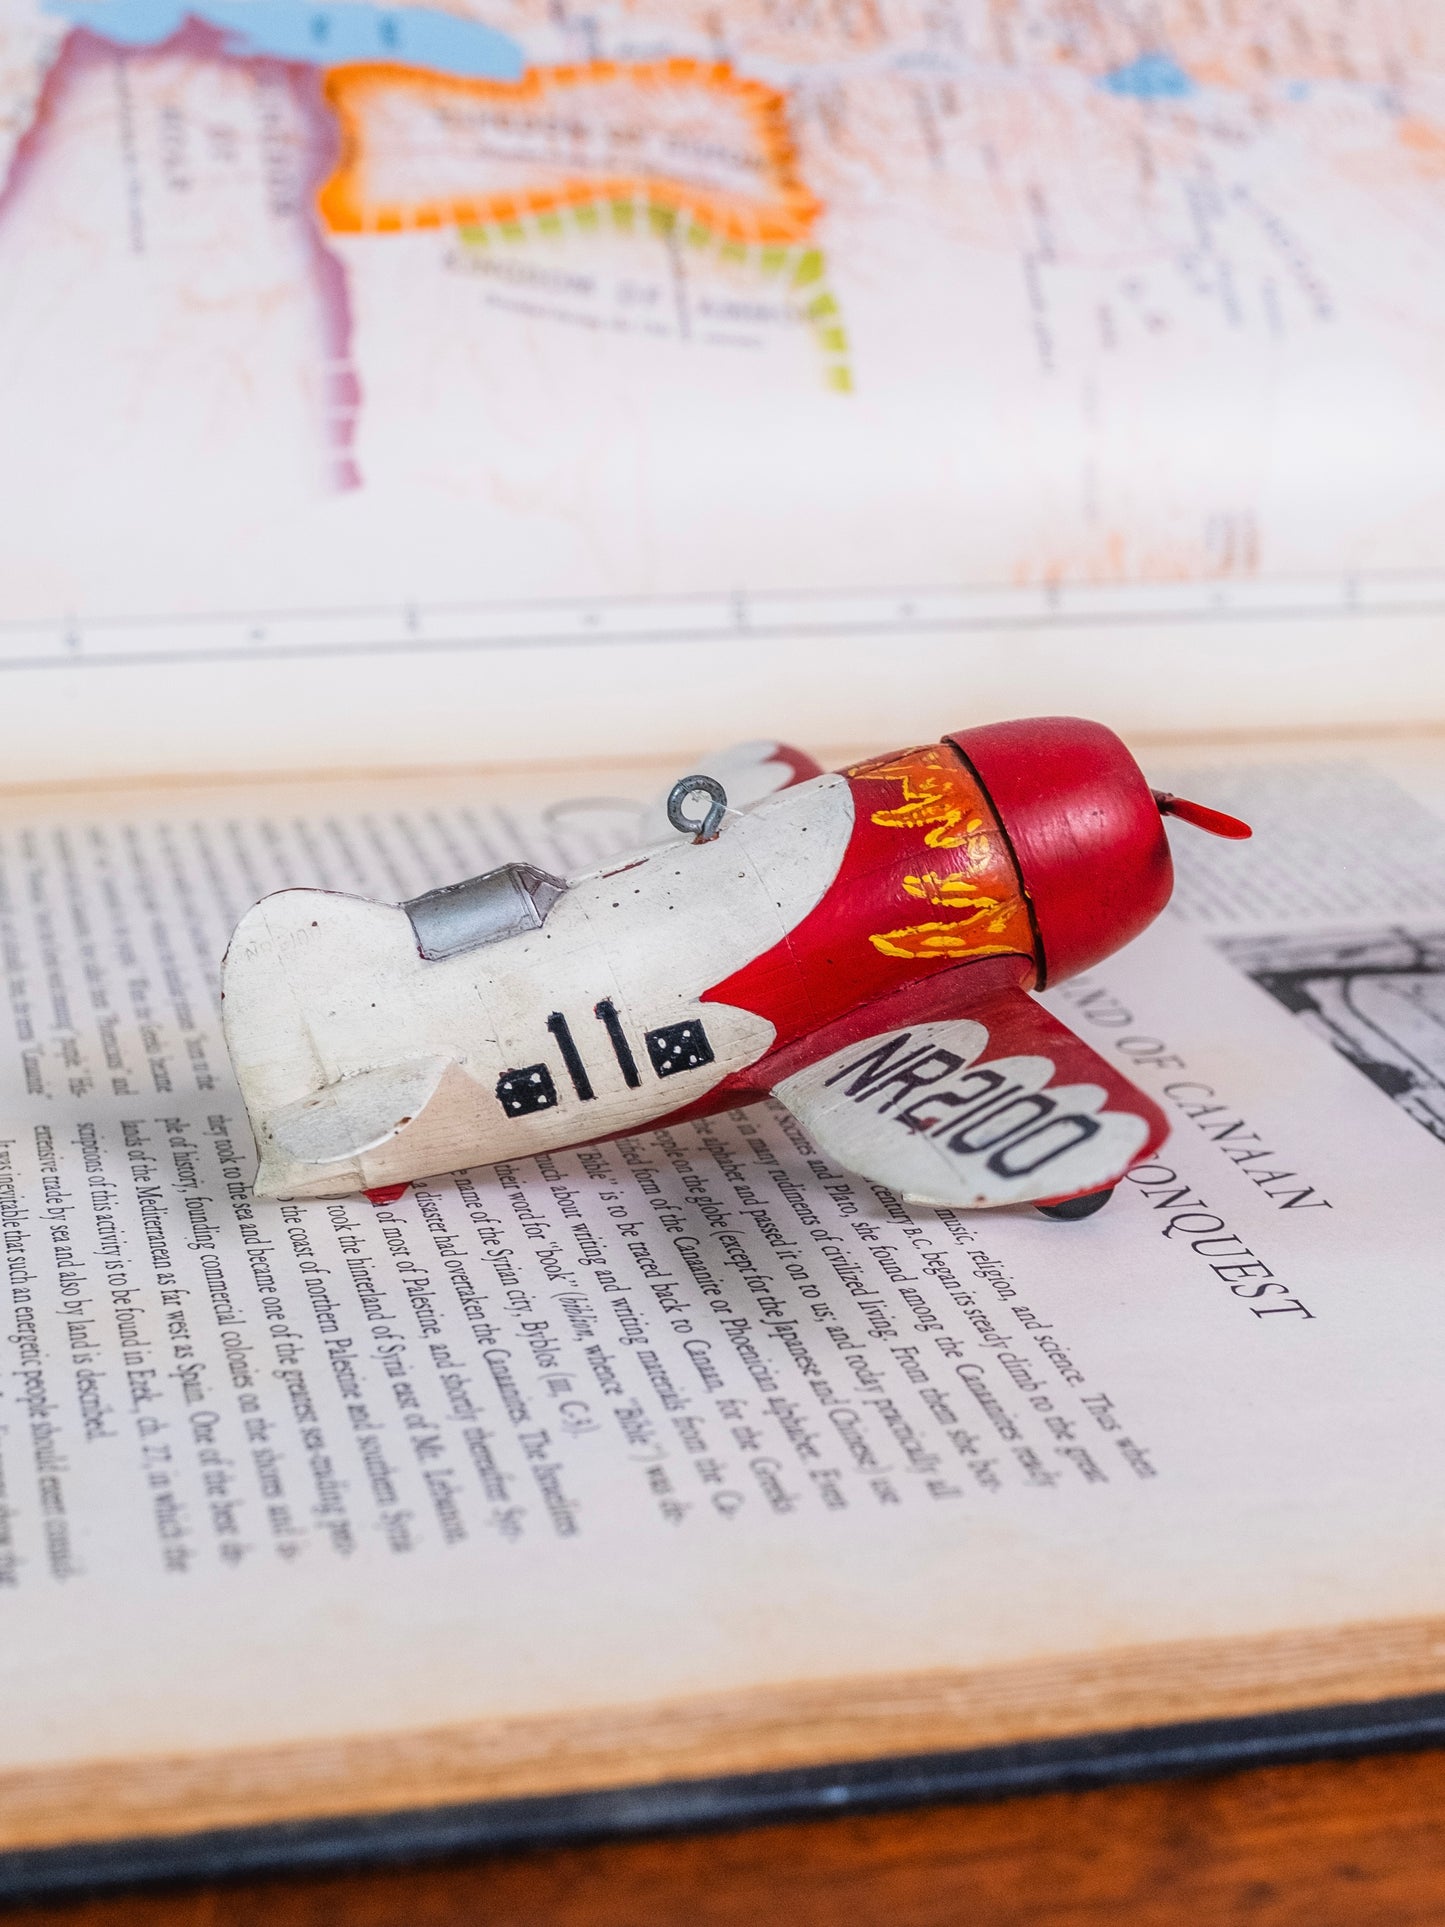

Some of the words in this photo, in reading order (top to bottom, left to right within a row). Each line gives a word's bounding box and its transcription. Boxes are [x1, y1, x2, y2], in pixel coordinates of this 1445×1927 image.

[824, 1033, 1101, 1180] NR2100
[1114, 1035, 1186, 1071] OF
[1163, 1081, 1333, 1211] CANAAN
[127, 1149, 157, 1162] of
[571, 1146, 618, 1185] “Bible”
[671, 1159, 693, 1174] on
[87, 1175, 118, 1188] of
[130, 1164, 157, 1182] the
[171, 1151, 204, 1193] history,
[222, 1166, 242, 1179] to
[490, 1164, 526, 1189] their
[631, 1168, 661, 1195] form
[806, 1159, 845, 1180] and
[42, 1175, 72, 1204] trade
[226, 1180, 256, 1200] the
[406, 1181, 428, 1189] a
[453, 1178, 482, 1208] name
[598, 1191, 624, 1201] is
[681, 1175, 709, 1193] the
[733, 1185, 769, 1206] and
[0, 1173, 29, 1227] inevitable
[90, 1190, 119, 1211] this
[508, 1191, 545, 1220] word
[550, 1185, 582, 1218] about
[649, 1198, 682, 1211] of
[768, 1169, 820, 1225] rudiments
[823, 1183, 875, 1217] Plato,
[38, 1206, 75, 1221] by
[184, 1196, 220, 1250] founding
[232, 1202, 254, 1221] sea
[280, 1205, 307, 1223] the
[326, 1205, 360, 1232] took
[375, 1211, 407, 1223] of
[414, 1191, 447, 1232] disaster
[469, 1211, 502, 1223] of
[606, 1205, 628, 1218] to
[658, 1213, 687, 1233] the
[684, 1196, 731, 1227] globe
[49, 1224, 70, 1243] sea
[93, 1214, 127, 1256] activity
[136, 1186, 171, 1268] Mediterranean
[238, 1223, 272, 1245] and
[476, 1226, 504, 1245] the
[521, 1222, 551, 1239] for
[616, 1221, 644, 1237] be
[738, 1209, 797, 1247] passed
[809, 1229, 844, 1242] of
[850, 1222, 880, 1241] she
[1124, 1153, 1317, 1320] ONQUEST
[3, 1230, 30, 1254] that
[287, 1227, 314, 1257] coast
[337, 1235, 365, 1254] the
[382, 1227, 410, 1256] most
[433, 1234, 468, 1257] had
[571, 1223, 607, 1265] writing
[709, 1230, 757, 1273] (except
[872, 1181, 914, 1226] century
[902, 1227, 932, 1249] B.C.
[921, 1251, 961, 1289] began
[949, 1291, 976, 1306] its
[54, 1245, 85, 1268] and
[104, 1259, 132, 1270] is
[395, 1260, 429, 1273] of
[481, 1248, 521, 1286] Syrian
[535, 1241, 578, 1287] “book”
[627, 1241, 672, 1278] traced
[673, 1236, 723, 1295] Canaanite
[775, 1250, 802, 1260] it
[868, 1245, 918, 1282] found
[6, 1256, 37, 1285] such
[107, 1272, 127, 1286] to
[156, 1272, 176, 1285] as
[246, 1247, 276, 1293] became
[298, 1261, 331, 1274] of
[785, 1263, 809, 1281] on
[821, 1245, 879, 1296] civilized
[933, 1207, 978, 1246] music,
[967, 1250, 1016, 1301] religion,
[1011, 1306, 1053, 1330] and
[58, 1271, 87, 1296] also
[200, 1254, 245, 1325] commercial
[346, 1257, 395, 1320] hinterland
[444, 1260, 488, 1320] overtaken
[594, 1269, 632, 1292] and
[743, 1275, 773, 1293] for
[798, 1284, 821, 1298] to
[11, 1287, 31, 1304] an
[55, 1298, 93, 1315] by
[111, 1288, 140, 1304] be
[160, 1289, 190, 1305] far
[304, 1278, 340, 1333] northern
[503, 1289, 536, 1317] city,
[650, 1282, 690, 1313] back
[709, 1299, 732, 1314] or
[756, 1296, 786, 1317] the
[261, 1296, 285, 1320] one
[402, 1278, 443, 1338] Palestine,
[551, 1291, 597, 1341] (biblion,
[810, 1302, 837, 1322] us;
[898, 1287, 943, 1331] among
[114, 1307, 151, 1347] found
[167, 1310, 190, 1340] west
[269, 1324, 303, 1339] of
[371, 1325, 405, 1340] of
[611, 1297, 649, 1345] writing
[670, 1318, 693, 1333] to
[6, 1306, 41, 1366] energetic
[66, 1319, 100, 1349] land
[471, 1323, 501, 1345] the
[516, 1320, 560, 1368] Byblos
[825, 1326, 866, 1350] and
[71, 1352, 100, 1364] is
[122, 1350, 151, 1366] in
[173, 1344, 194, 1359] as
[220, 1331, 258, 1388] colonies
[275, 1342, 304, 1364] the
[371, 1344, 406, 1378] Syria
[428, 1344, 465, 1368] and
[11, 1369, 57, 1418] people
